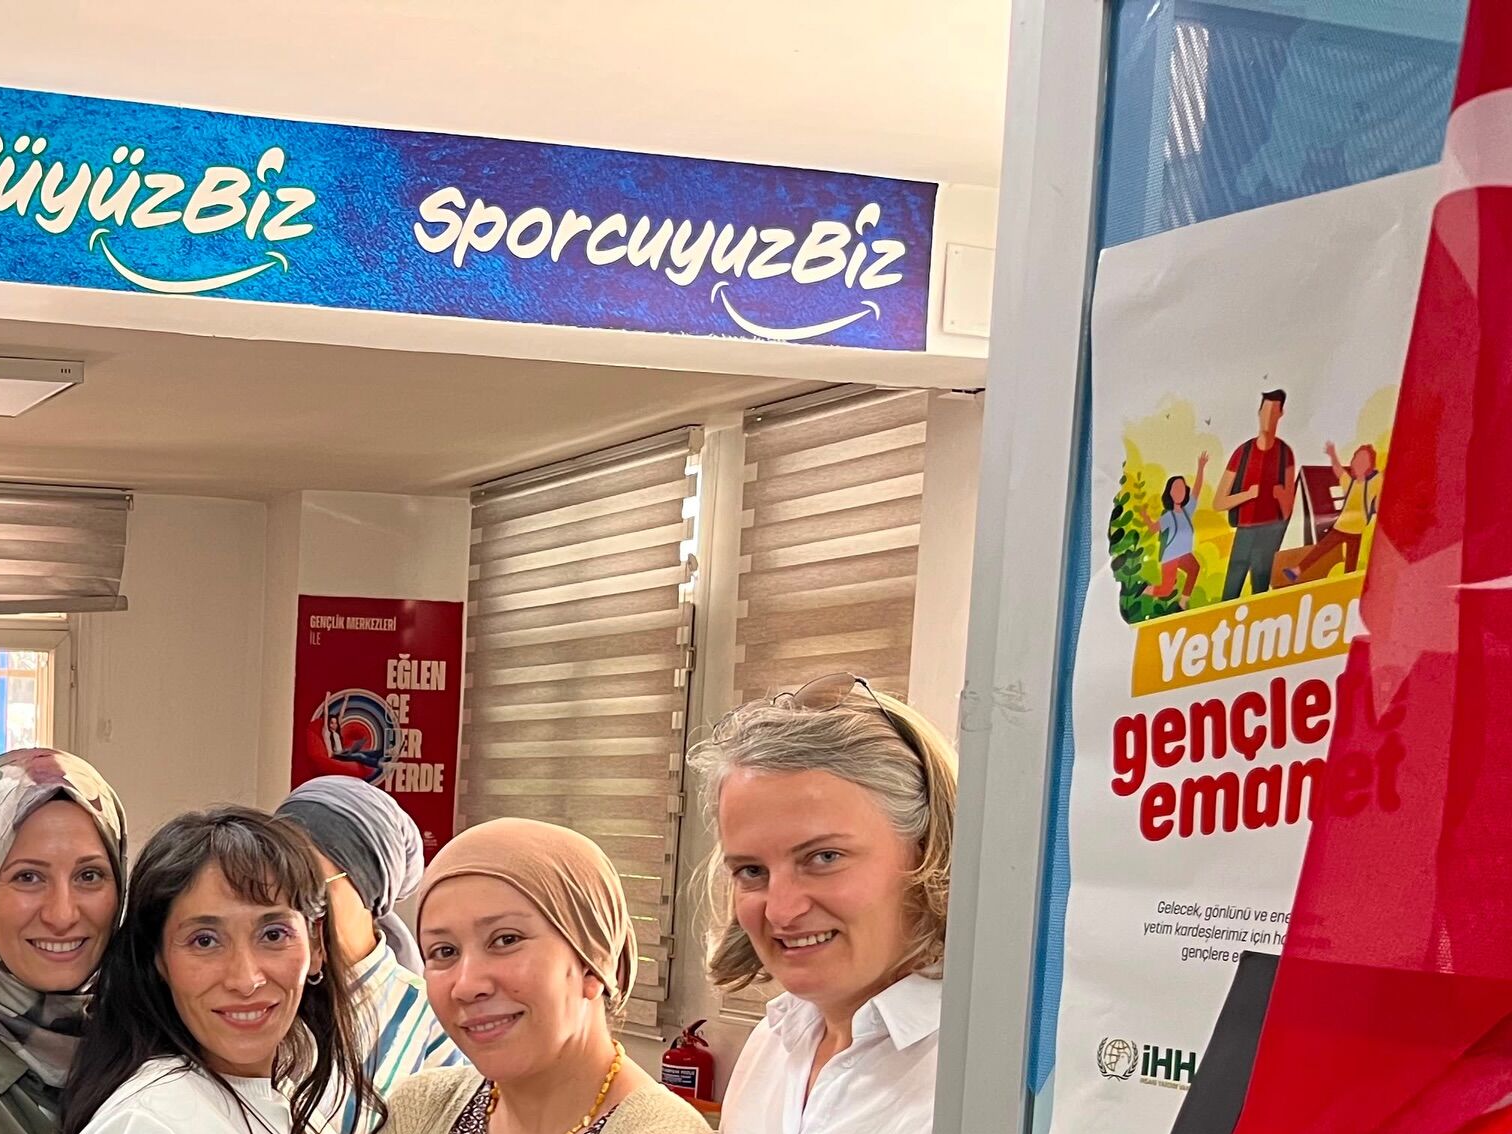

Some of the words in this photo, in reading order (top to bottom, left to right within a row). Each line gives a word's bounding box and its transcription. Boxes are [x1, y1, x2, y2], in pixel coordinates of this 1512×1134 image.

[414, 186, 907, 290] SporcuyuzBiz
[310, 614, 345, 631] GENÇLİK
[346, 616, 397, 631] MERKEZLERİ
[309, 630, 321, 646] İLE
[386, 653, 447, 691] EĞLEN
[382, 761, 445, 793] YERDE
[1157, 900, 1203, 918] Gelecek,
[1204, 904, 1251, 921] gönlünü
[1254, 910, 1268, 922] ve
[1143, 921, 1173, 936] yetim
[1174, 922, 1248, 943] kardeşlerimiz
[1250, 929, 1271, 946] için
[1181, 946, 1230, 962] gençlere
